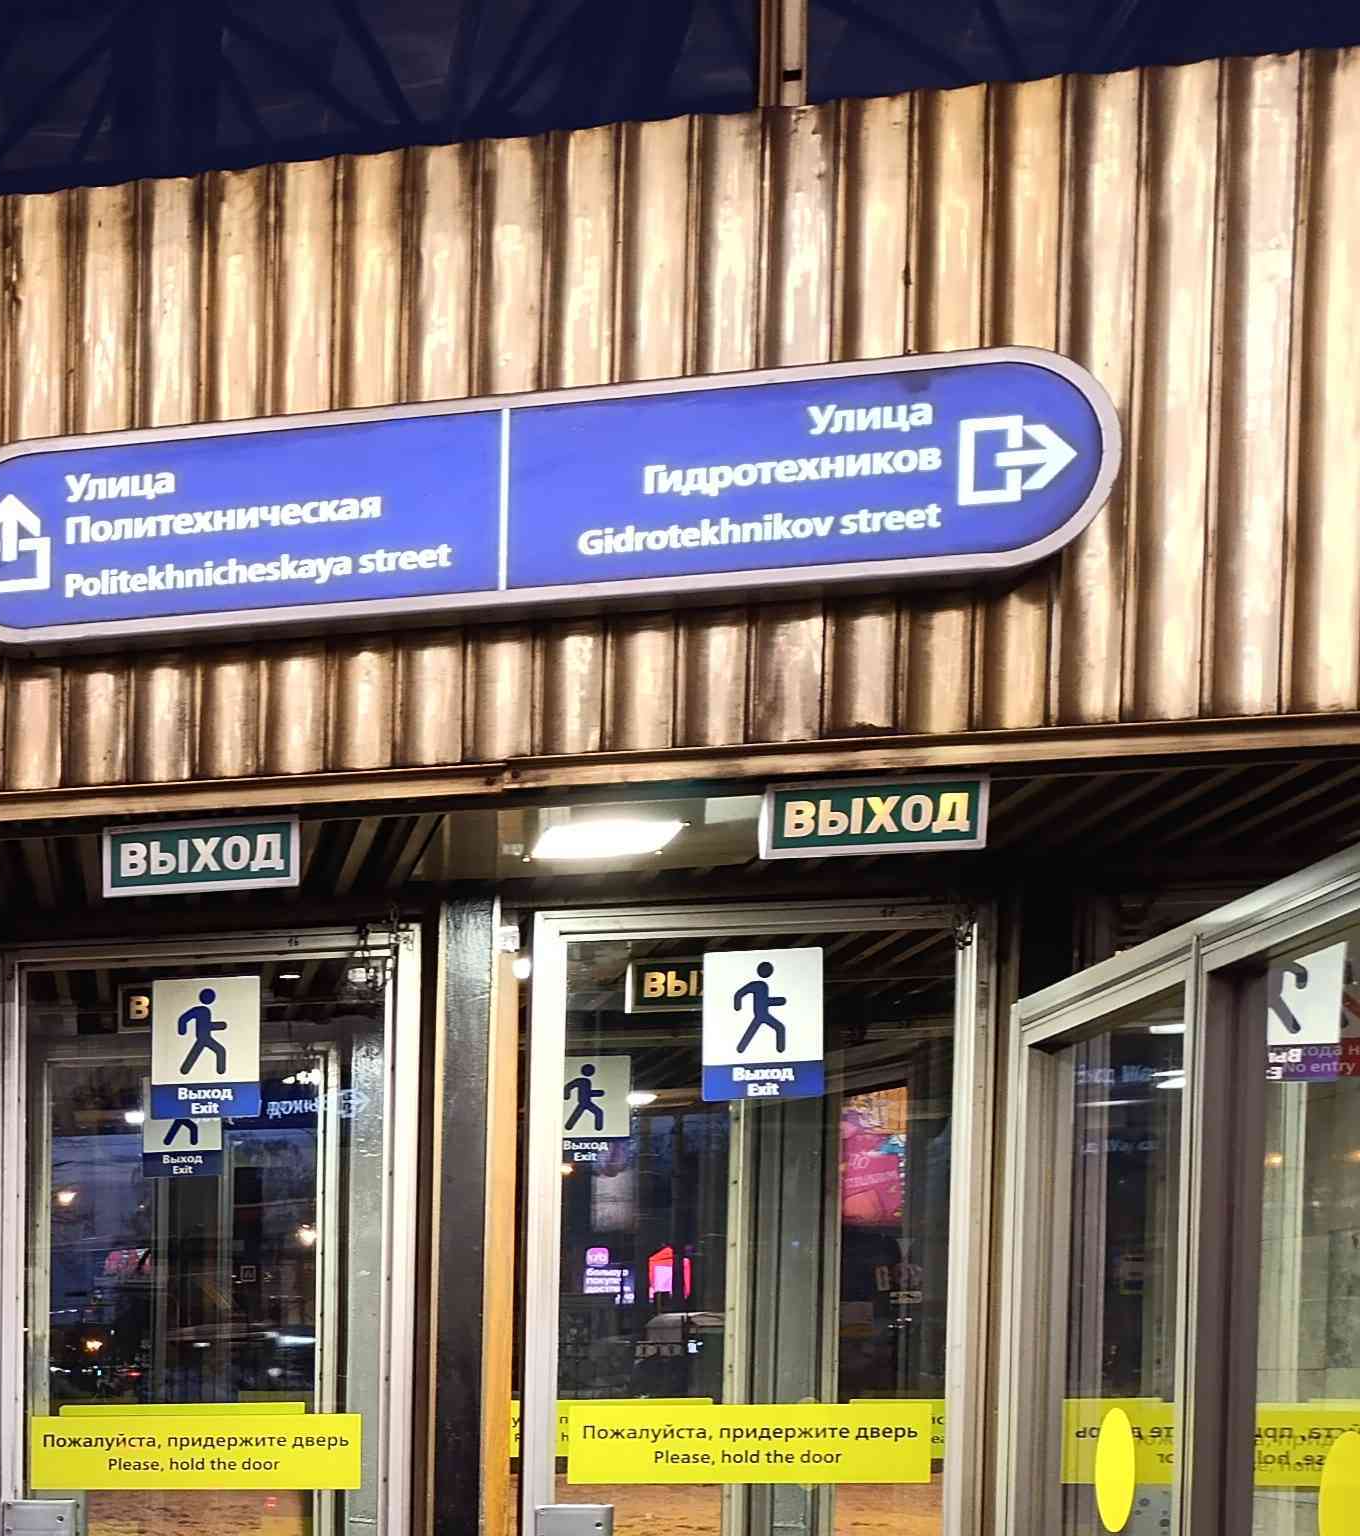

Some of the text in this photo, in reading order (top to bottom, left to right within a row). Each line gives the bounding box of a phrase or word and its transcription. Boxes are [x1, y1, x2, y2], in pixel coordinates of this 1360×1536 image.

[808, 402, 933, 435] Улица
[643, 446, 942, 496] Гидротехников
[65, 471, 176, 503] Улица
[65, 496, 382, 544] Политехническая
[578, 504, 942, 556] Gidrotekhnikov street
[65, 544, 452, 598] Politekhnicheskaya street
[783, 792, 971, 838] ВЫХОД
[120, 833, 285, 877] ВЫХОД
[732, 1067, 794, 1082] Выход
[1310, 1061, 1356, 1075] entry
[177, 1087, 233, 1101] Выход
[747, 1082, 780, 1097] Exit
[191, 1102, 220, 1114] Exit
[563, 1140, 609, 1152] Выход
[162, 1155, 203, 1164] Выход
[573, 1152, 598, 1162] Exit
[172, 1165, 193, 1174] Exit
[582, 1425, 713, 1442] Пожалуйста,
[719, 1425, 851, 1441] придержите
[855, 1426, 918, 1442] дверь
[43, 1434, 349, 1450] Пожалуйста, придержите дверь
[108, 1458, 280, 1472] Please, hold the door
[654, 1450, 842, 1466] Please, hold the door
